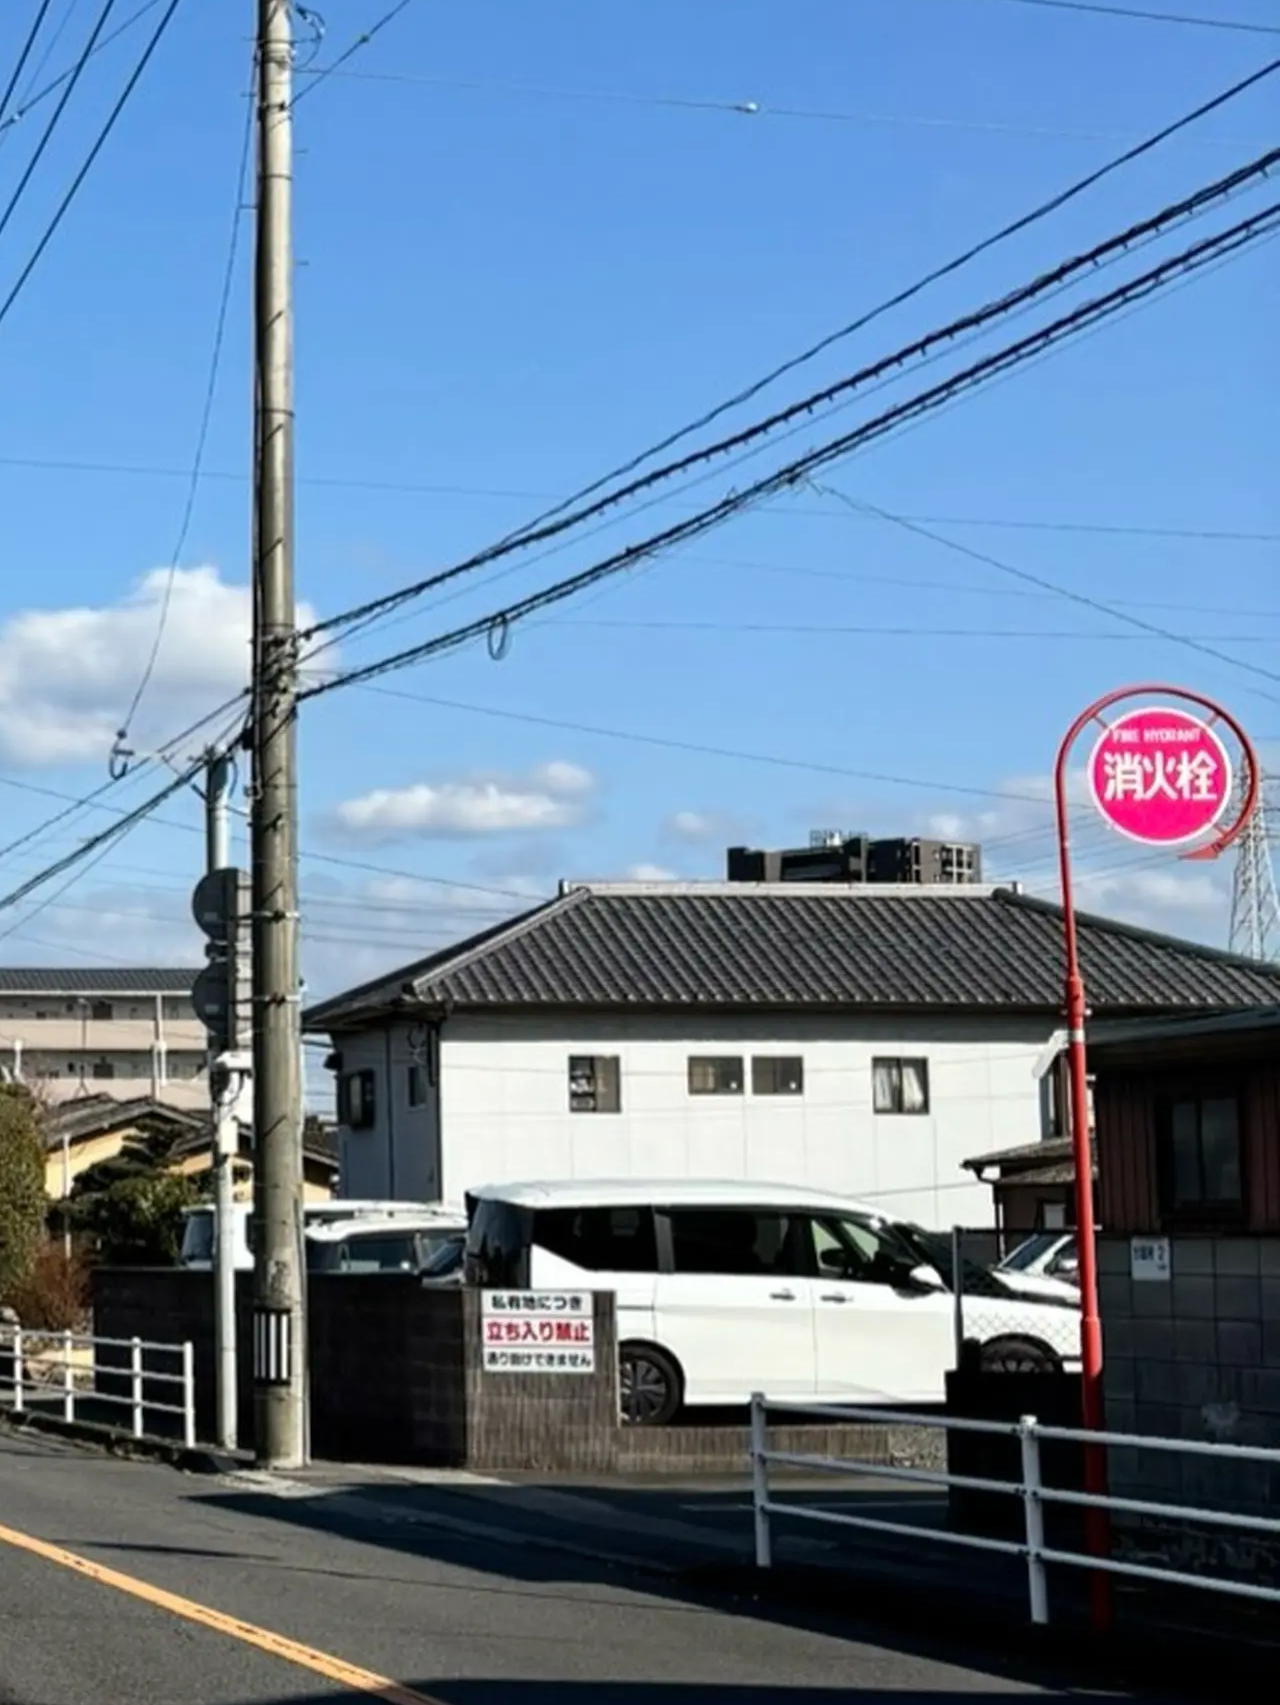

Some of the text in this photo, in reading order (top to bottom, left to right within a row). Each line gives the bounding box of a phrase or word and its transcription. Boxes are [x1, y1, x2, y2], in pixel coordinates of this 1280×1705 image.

[1103, 750, 1218, 801] 消火栓
[492, 1295, 583, 1311] 私有地につき
[487, 1321, 590, 1342] 立ち入り禁止
